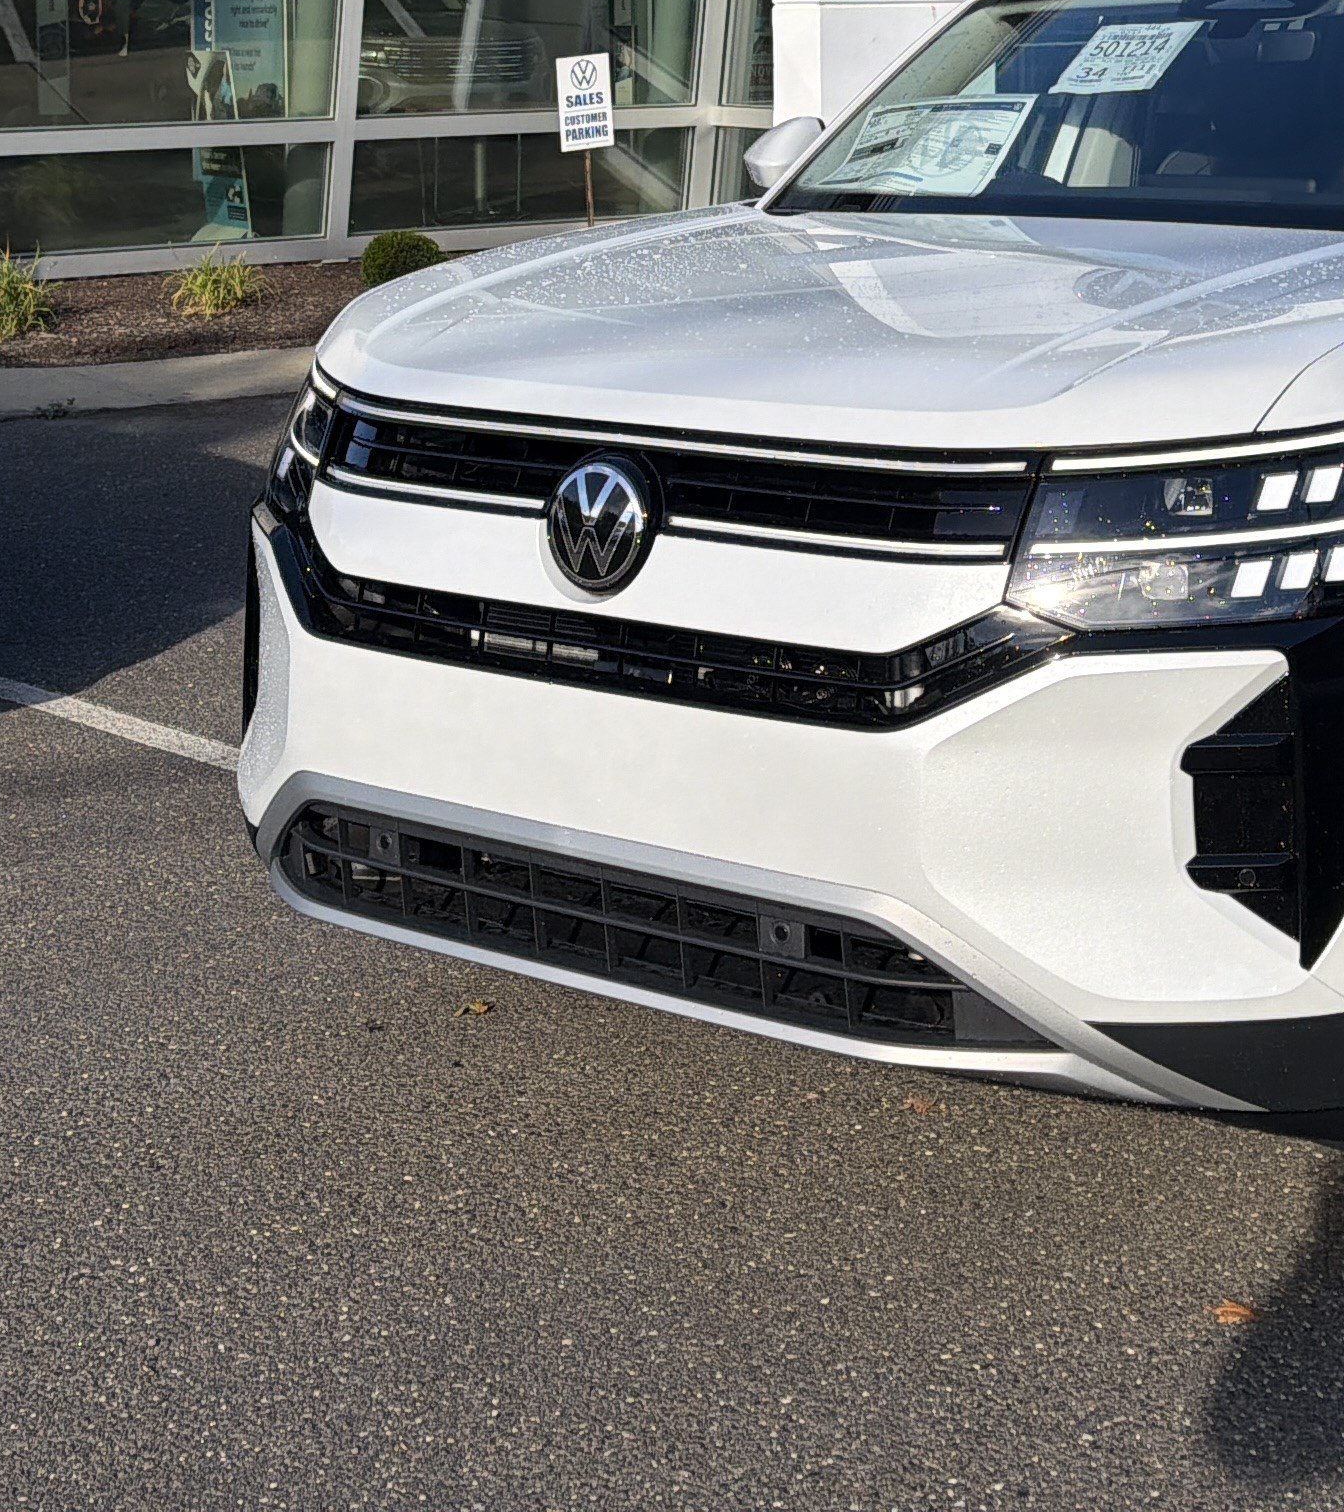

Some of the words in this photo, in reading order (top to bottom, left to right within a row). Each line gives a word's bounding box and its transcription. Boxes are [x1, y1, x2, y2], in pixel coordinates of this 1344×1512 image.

[1089, 37, 1170, 58] 501214
[1076, 67, 1109, 79] 34
[565, 91, 604, 108] SALES
[564, 111, 608, 127] CUSTOMER
[565, 124, 609, 143] PARKING
